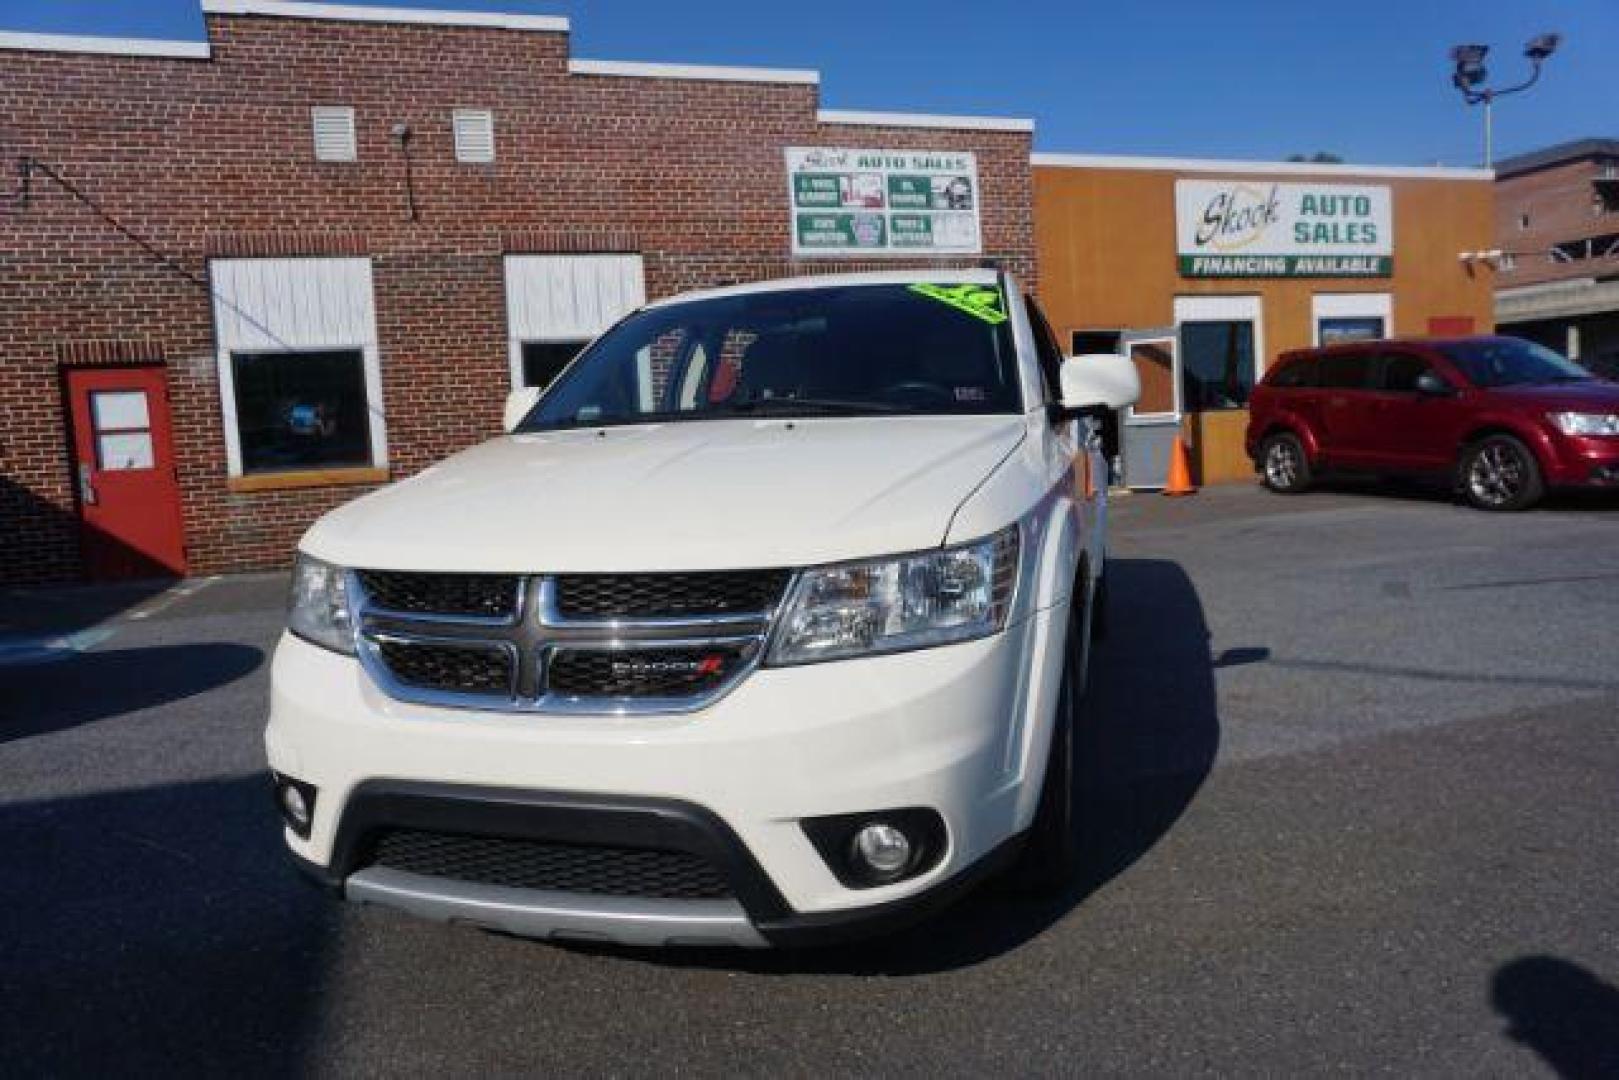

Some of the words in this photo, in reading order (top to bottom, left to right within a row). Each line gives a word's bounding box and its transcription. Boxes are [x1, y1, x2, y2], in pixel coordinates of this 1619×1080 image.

[857, 156, 906, 168] AUTO
[912, 157, 967, 170] SALES
[1195, 184, 1281, 246] Skook
[1300, 194, 1372, 217] AUTO
[1294, 222, 1377, 244] SALES
[1193, 257, 1286, 274] FINANCING
[1294, 257, 1379, 274] AVAILABLE
